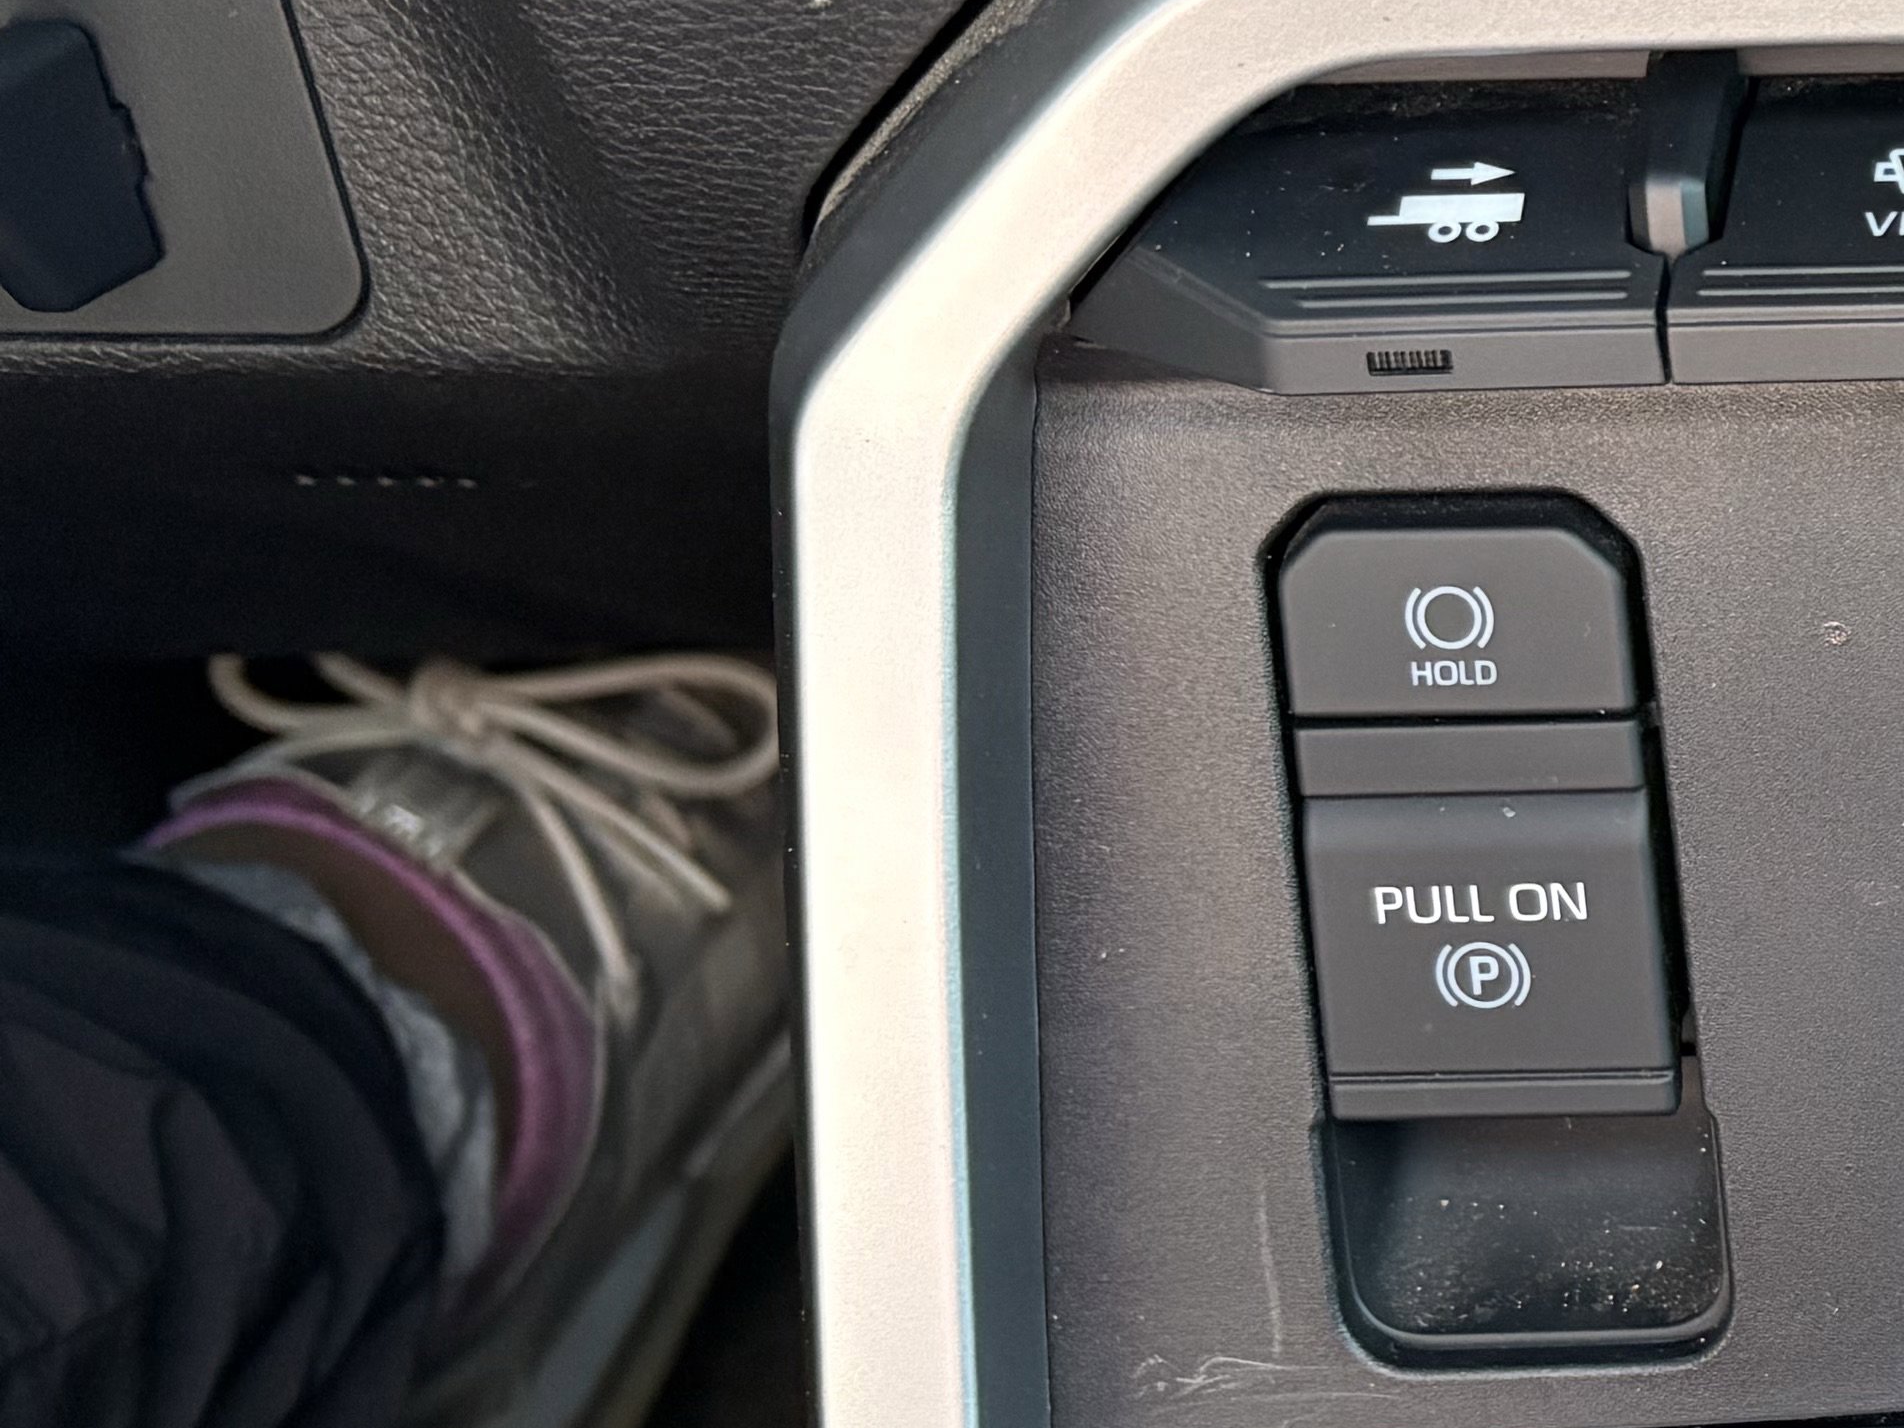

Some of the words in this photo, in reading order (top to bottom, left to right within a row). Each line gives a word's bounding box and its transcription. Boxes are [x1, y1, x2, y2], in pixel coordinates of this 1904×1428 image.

[1410, 659, 1497, 686] HOLD
[1373, 884, 1495, 925] PULL
[1508, 881, 1588, 922] ON
